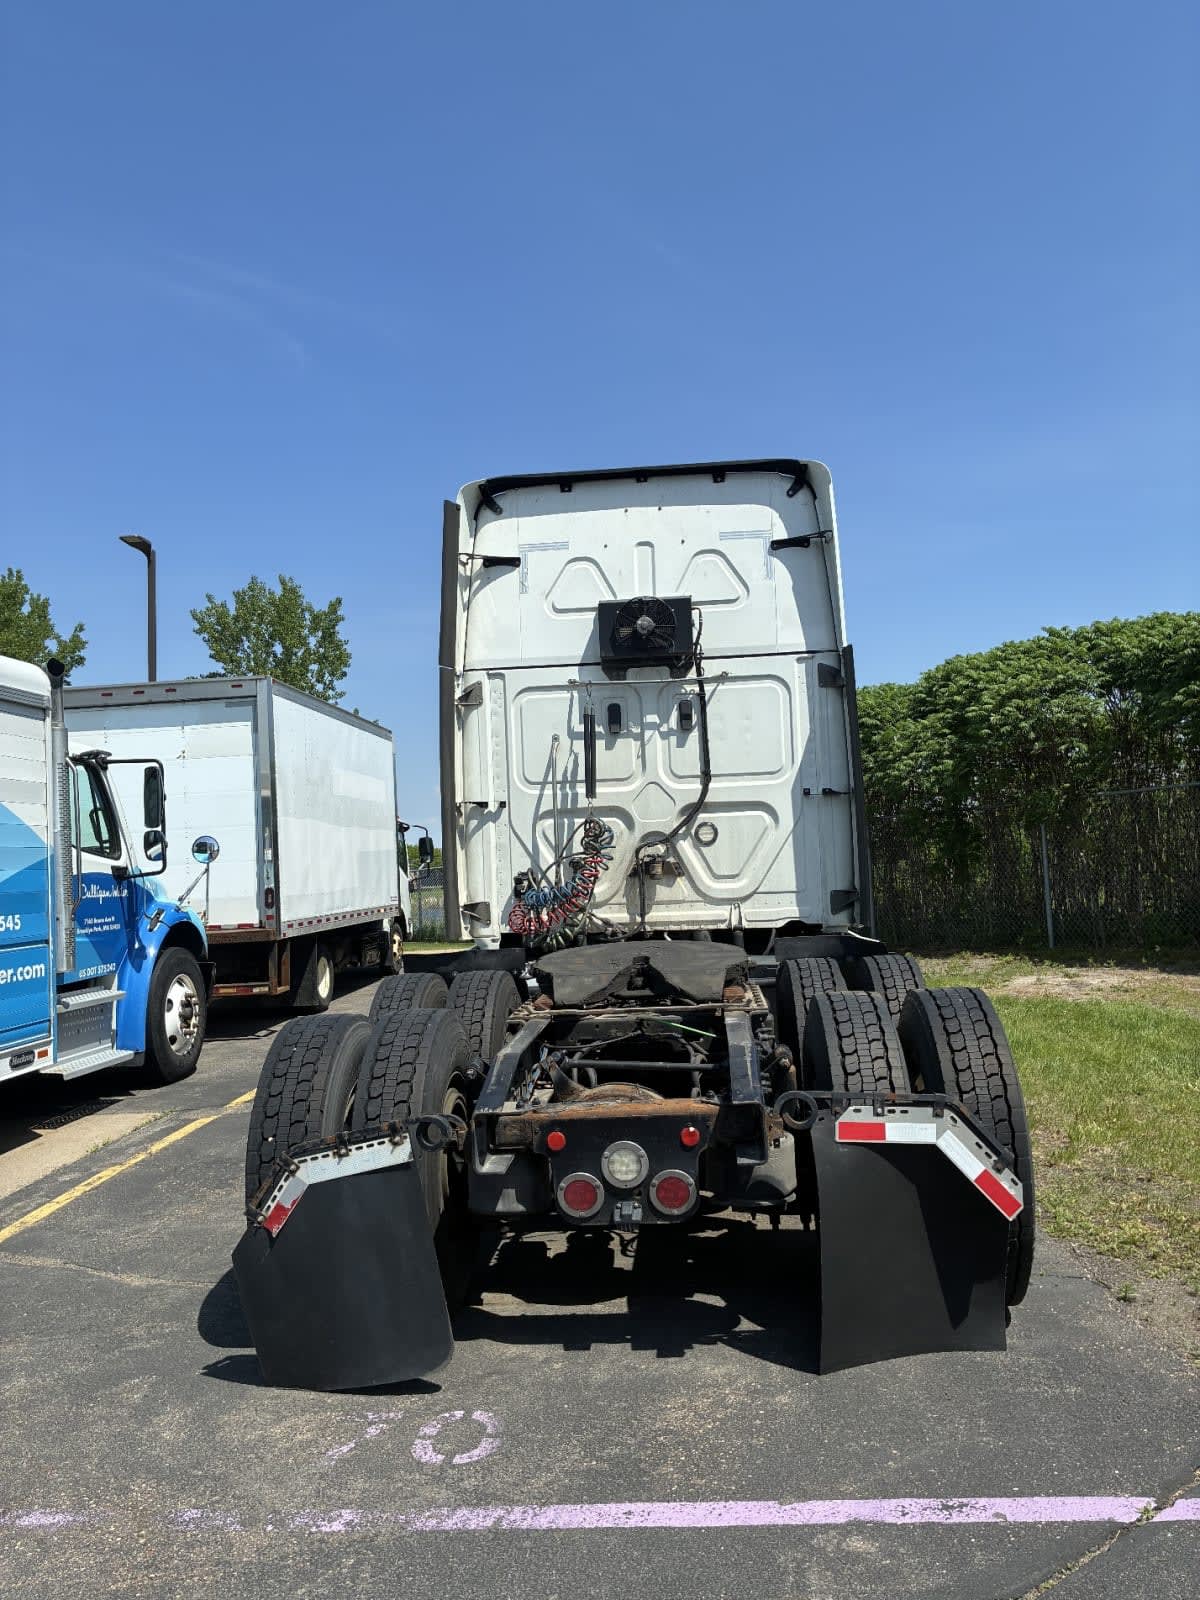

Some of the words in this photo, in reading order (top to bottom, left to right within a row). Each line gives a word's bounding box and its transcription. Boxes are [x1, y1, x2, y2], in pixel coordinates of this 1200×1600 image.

[81, 883, 110, 905] Culligan
[0, 963, 45, 985] er.com
[87, 966, 97, 977] DOT
